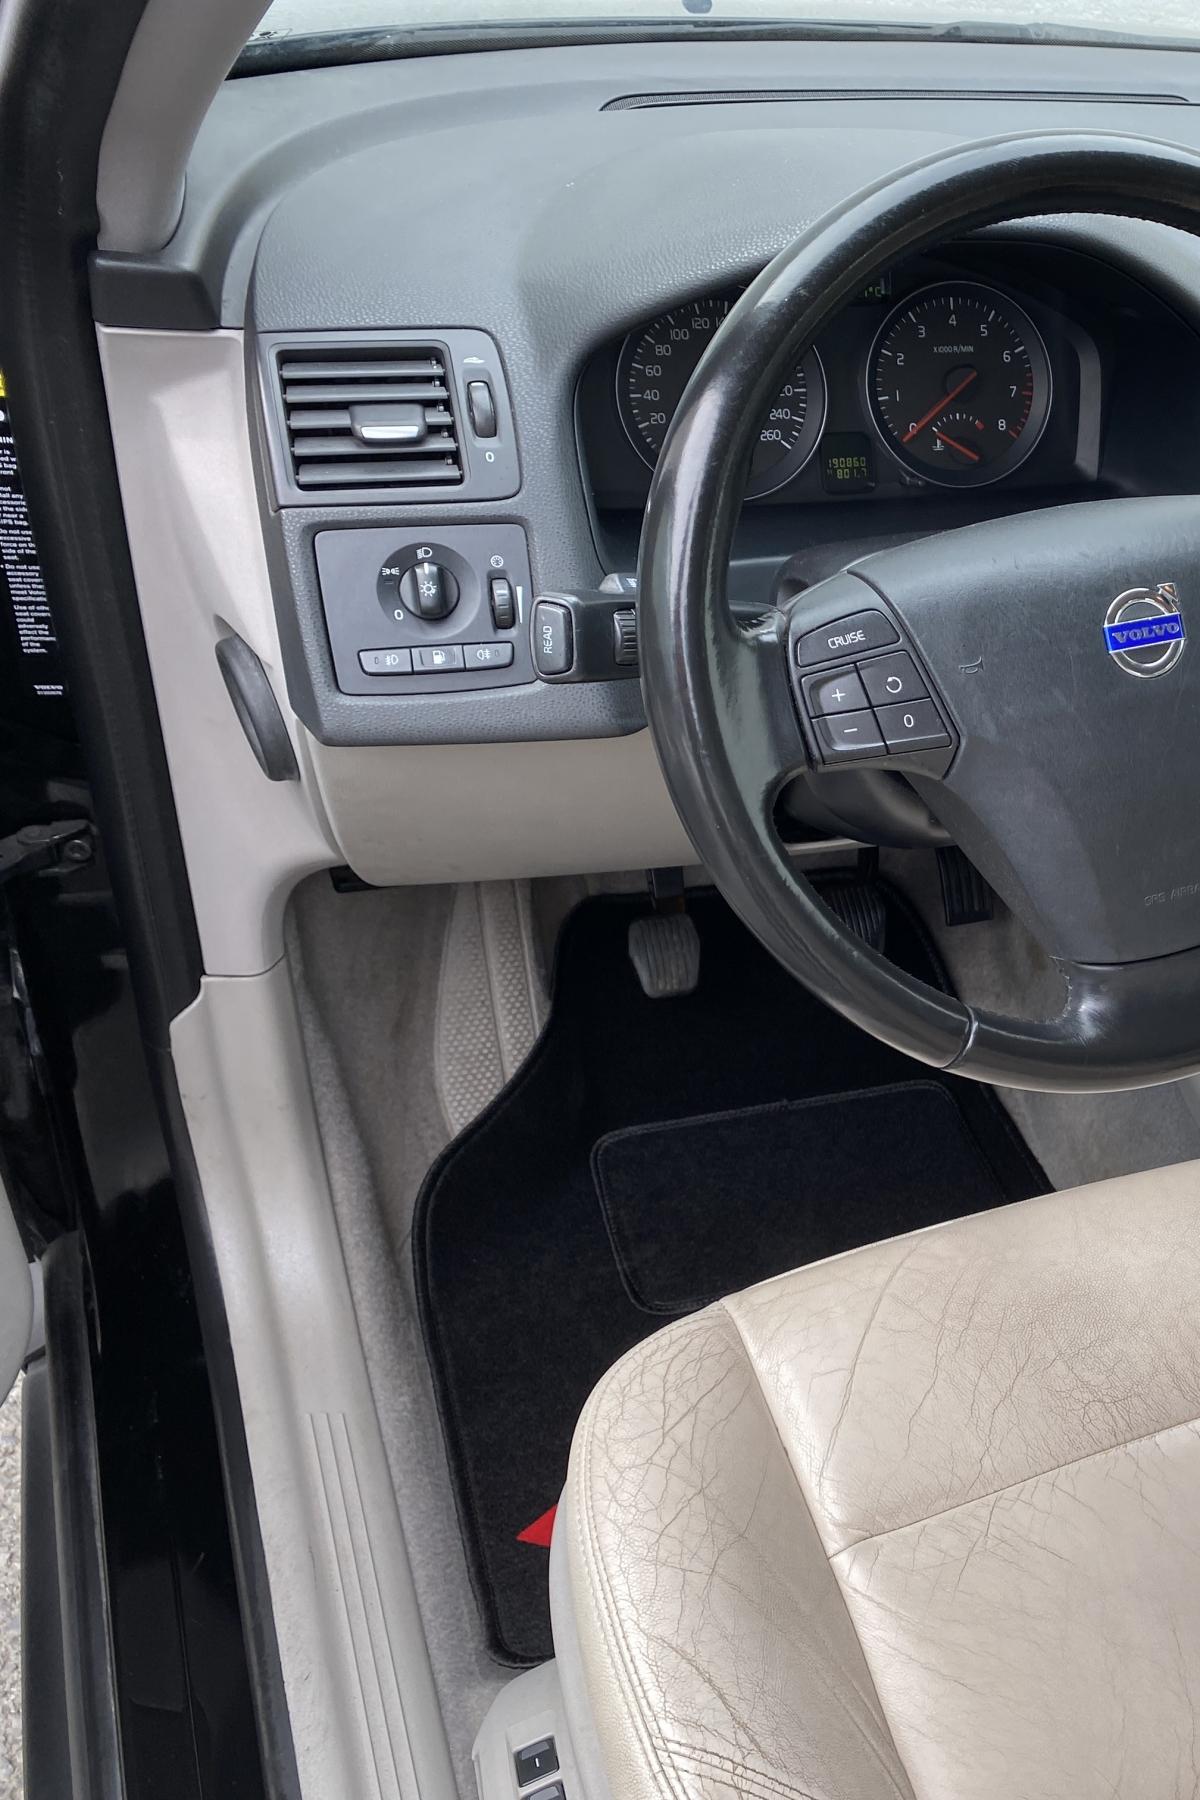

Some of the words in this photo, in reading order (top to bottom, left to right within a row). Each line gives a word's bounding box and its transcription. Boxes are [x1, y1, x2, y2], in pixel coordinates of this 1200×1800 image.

[692, 318, 709, 329] 120
[948, 315, 957, 326] 4
[670, 329, 689, 340] 100
[918, 326, 926, 338] 3
[980, 325, 988, 336] 5
[655, 345, 671, 356] 80
[896, 354, 904, 365] 2
[1003, 351, 1011, 363] 6
[645, 366, 661, 376] 60
[643, 390, 660, 400] 40
[1009, 386, 1017, 398] 7
[650, 413, 666, 424] 20
[769, 408, 791, 420] 240
[998, 419, 1006, 430] 8
[760, 430, 781, 441] 260
[485, 451, 495, 463] 0
[394, 609, 404, 621] 0
[1112, 622, 1180, 643] VOLVO
[543, 625, 553, 654] READ
[828, 630, 866, 649] CRUISE
[904, 714, 914, 727] 0
